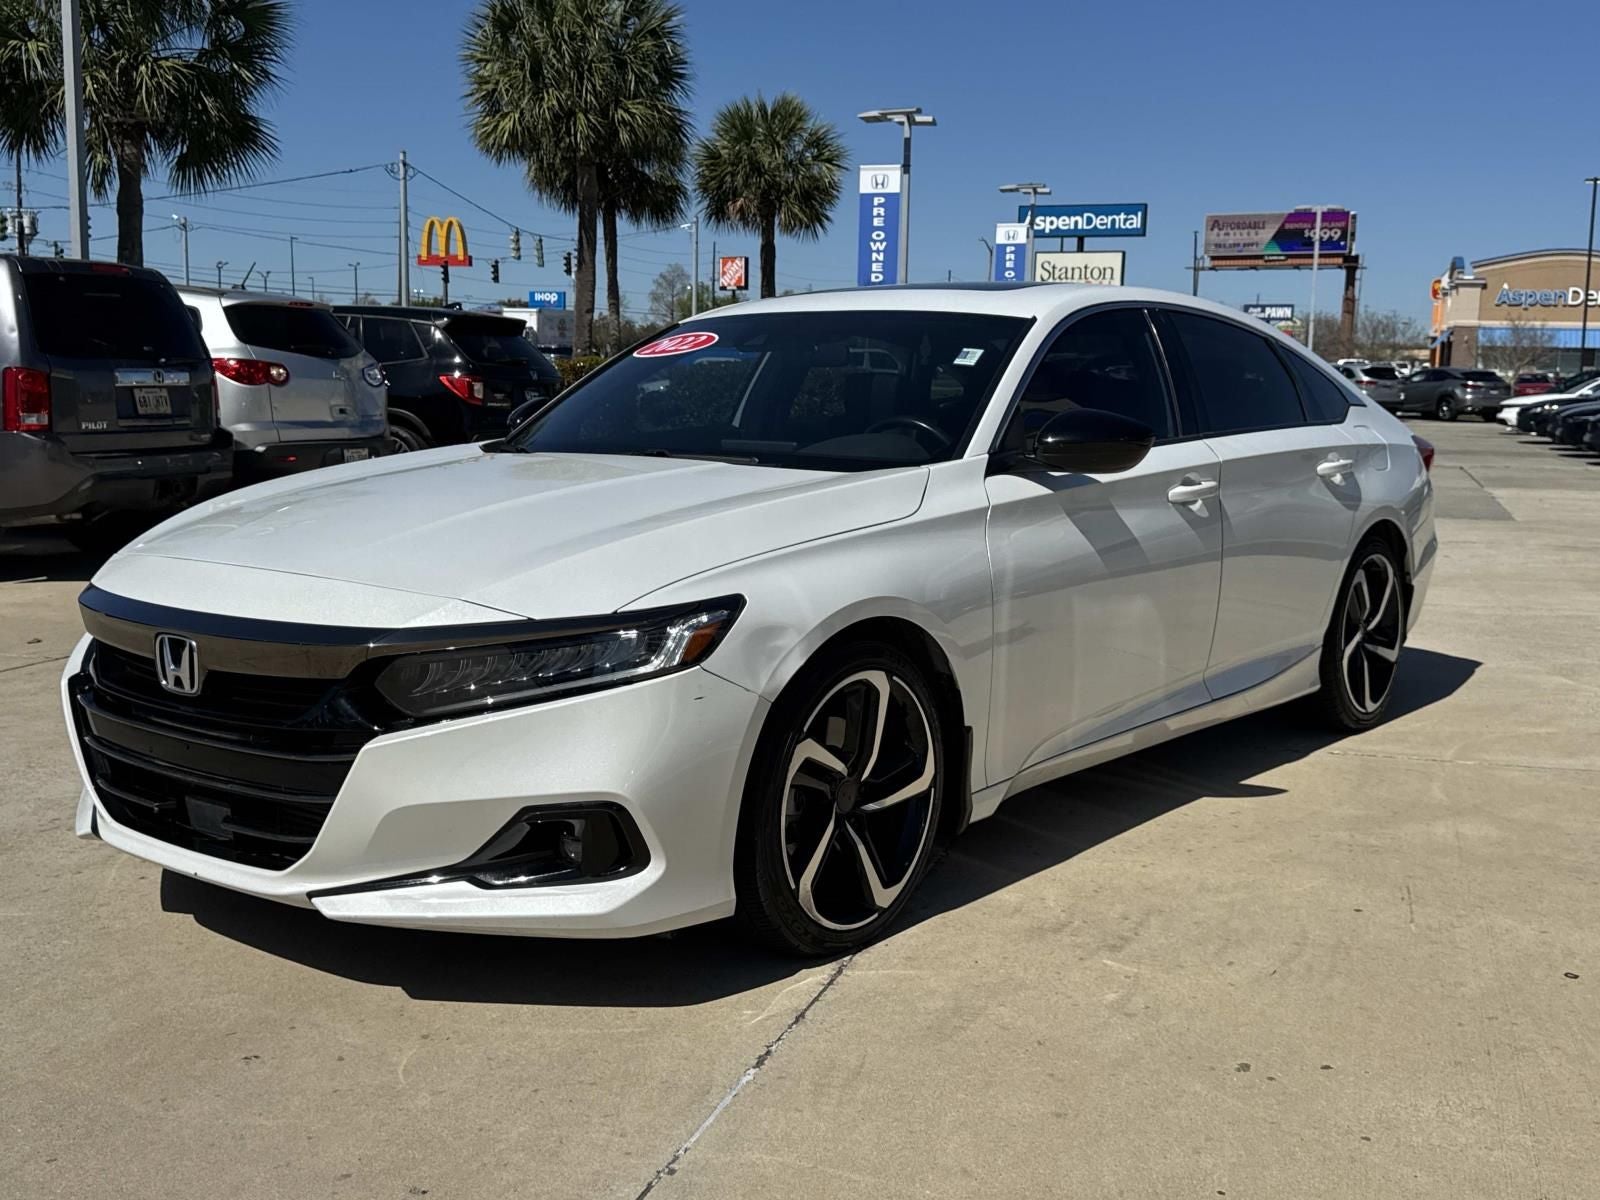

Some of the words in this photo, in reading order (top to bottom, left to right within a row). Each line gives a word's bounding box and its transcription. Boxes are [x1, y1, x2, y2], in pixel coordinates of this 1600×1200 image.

[872, 196, 886, 227] PRE
[1210, 219, 1266, 231] AFFORDABLE
[1303, 228, 1342, 242] $999
[869, 230, 887, 283] OWNED
[1004, 246, 1016, 268] PRE
[1040, 260, 1114, 281] Stanton
[1495, 282, 1600, 309] AspenDe
[1265, 307, 1292, 318] PAWN
[639, 335, 709, 355] 2022
[81, 421, 108, 430] PILOT
